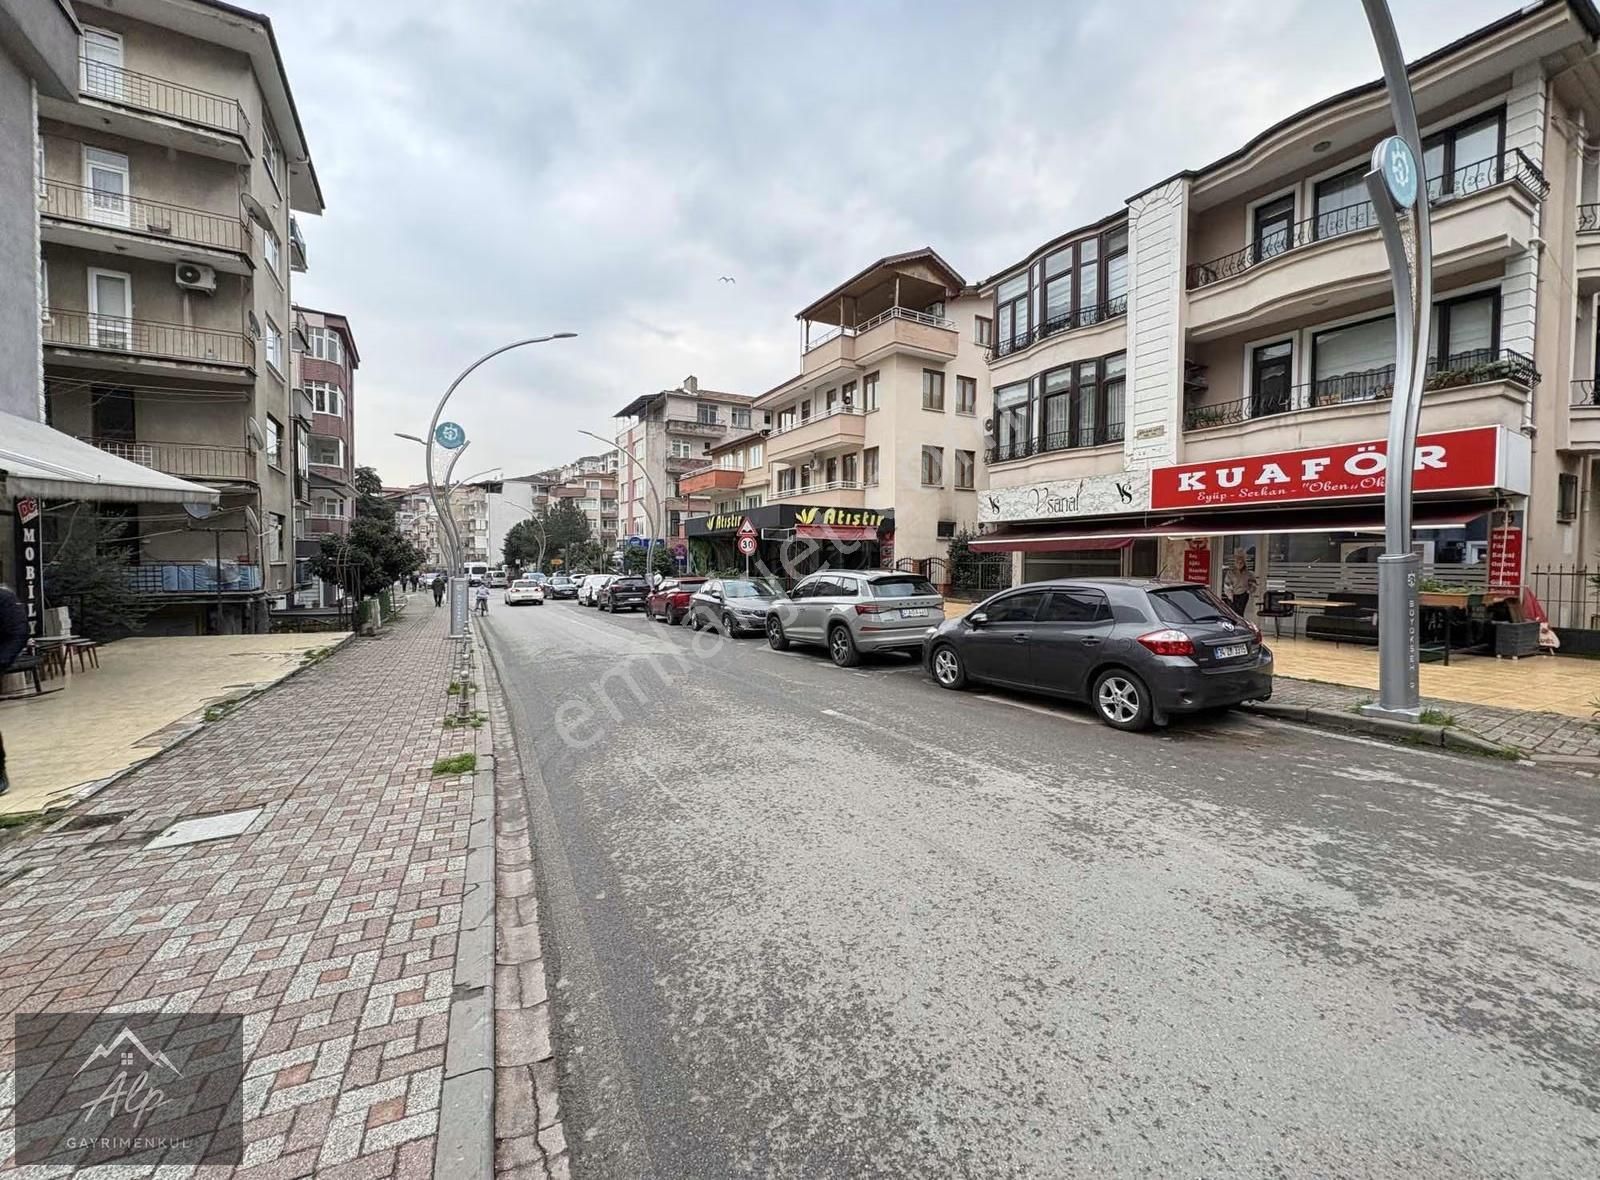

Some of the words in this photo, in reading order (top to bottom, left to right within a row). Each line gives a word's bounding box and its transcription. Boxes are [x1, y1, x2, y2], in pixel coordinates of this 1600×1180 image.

[1178, 446, 1447, 491] KUAFÖR
[1239, 486, 1286, 497] Serkan
[743, 541, 753, 549] 30
[23, 528, 37, 635] MOBİLY
